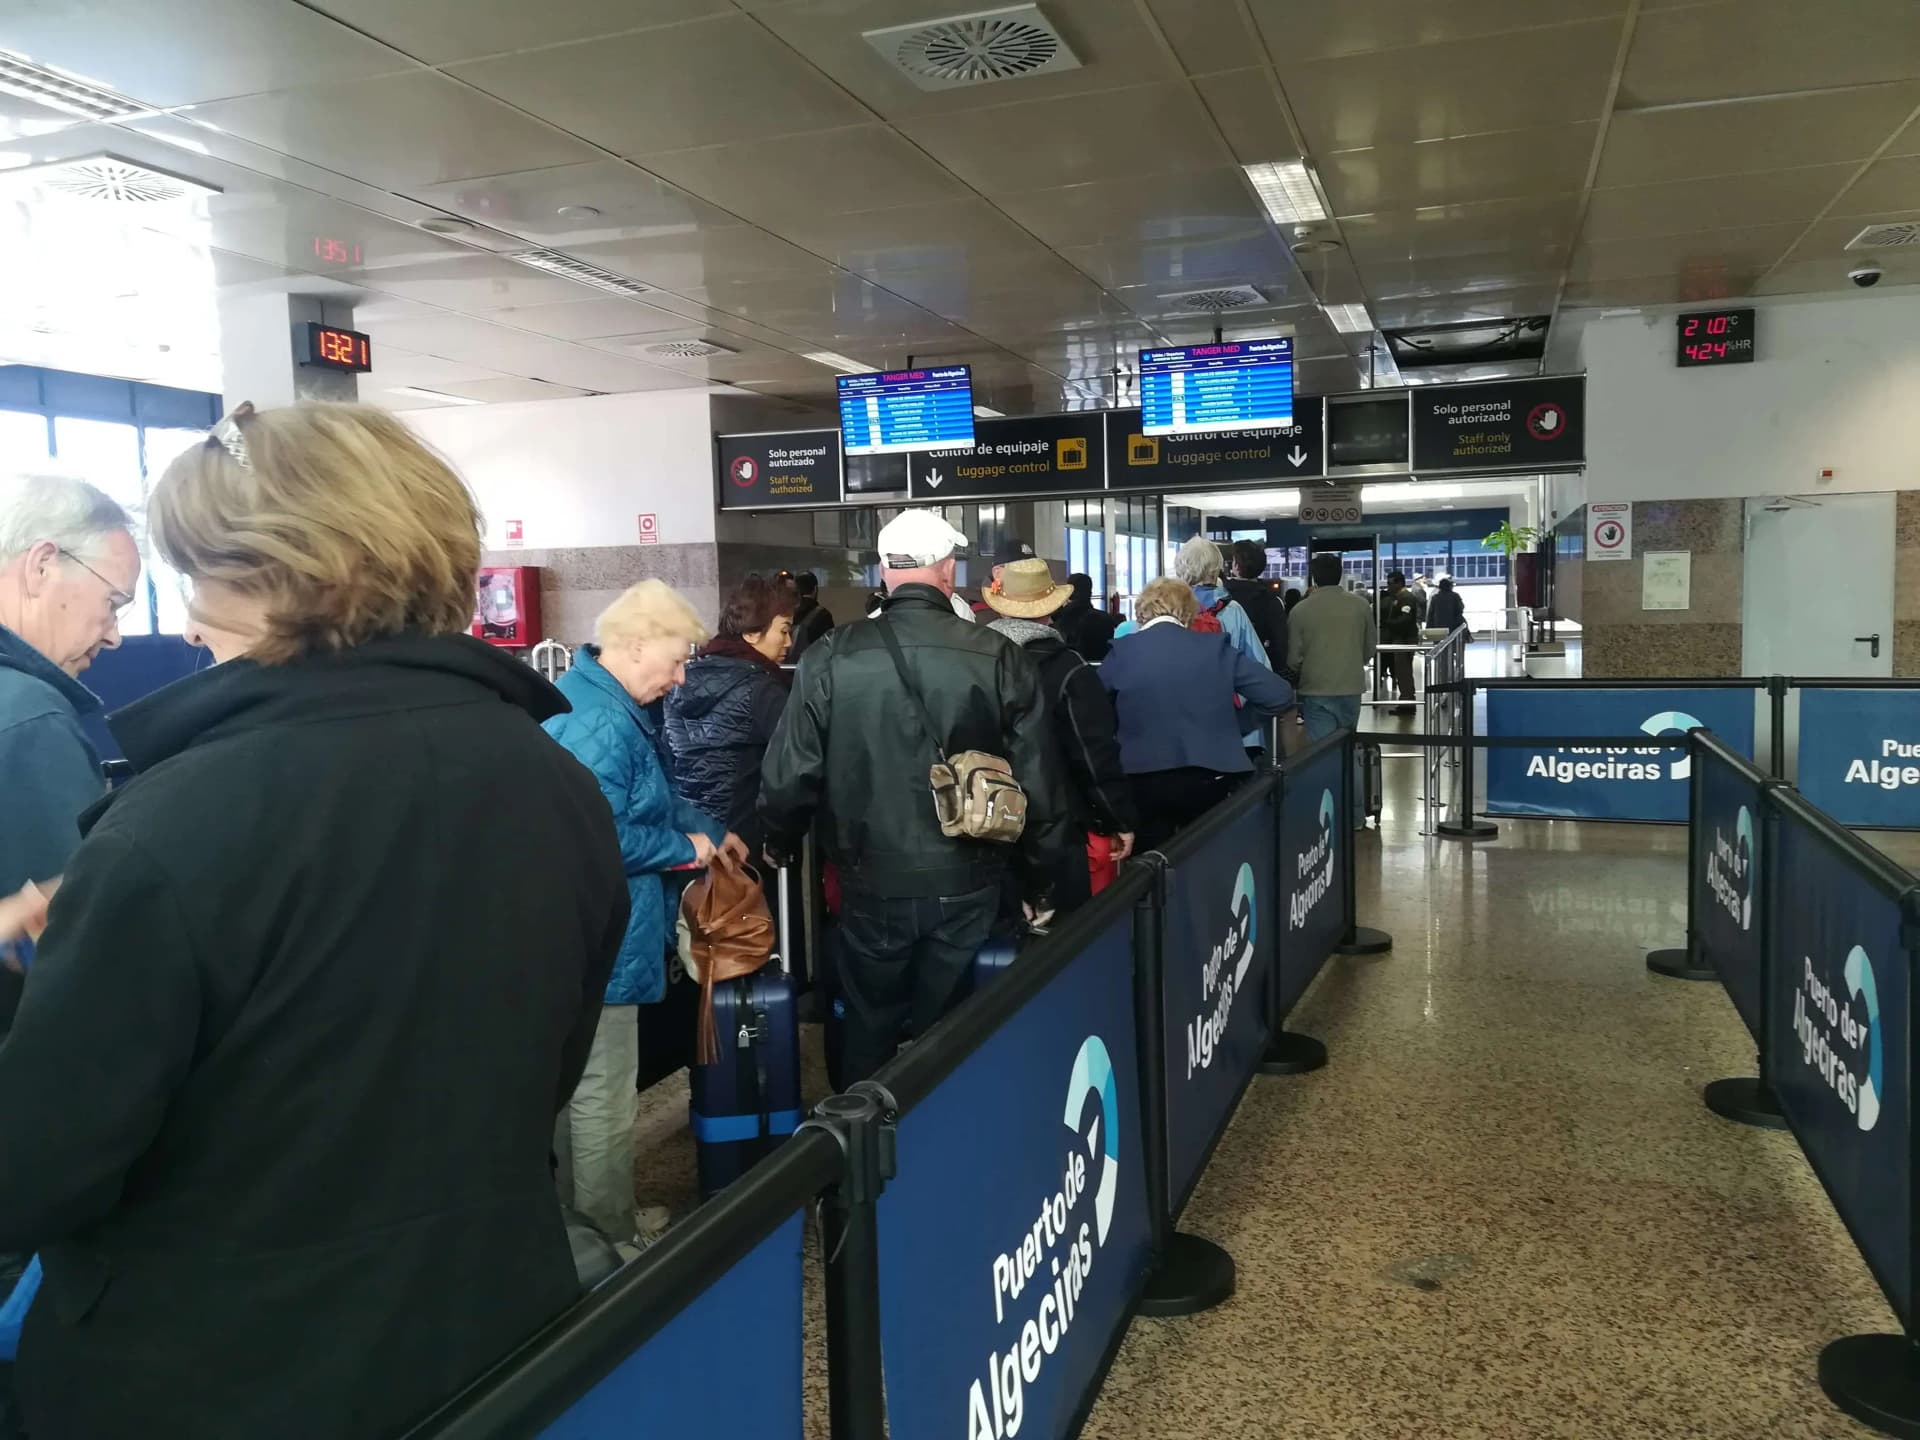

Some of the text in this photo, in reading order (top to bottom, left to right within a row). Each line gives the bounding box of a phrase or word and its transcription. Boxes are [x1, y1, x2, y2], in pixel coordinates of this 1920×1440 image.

[1192, 345, 1241, 356] TANGER MED
[883, 373, 908, 382] TANGER
[909, 371, 925, 380] MED
[1433, 399, 1511, 415] Solo personal
[1448, 411, 1511, 425] autorizado
[1458, 431, 1511, 445] Staff only
[768, 445, 826, 460] Solo personal
[977, 443, 993, 456] de
[995, 440, 1049, 457] equipaje
[1167, 445, 1271, 466] Luggage control
[1453, 442, 1512, 456] authorized
[768, 456, 815, 468] autorizado
[956, 460, 1050, 479] Luggage control
[769, 474, 807, 486] Staff only
[770, 483, 813, 494] authorized
[1526, 755, 1661, 783] Algeciras
[1844, 759, 1920, 790] Alge
[1223, 926, 1238, 961] de
[1804, 955, 1857, 1050] Puerto de
[1793, 986, 1857, 1115] Algeciras
[992, 1150, 1086, 1325] Puerto de
[966, 1221, 1093, 1440] Algeciras
